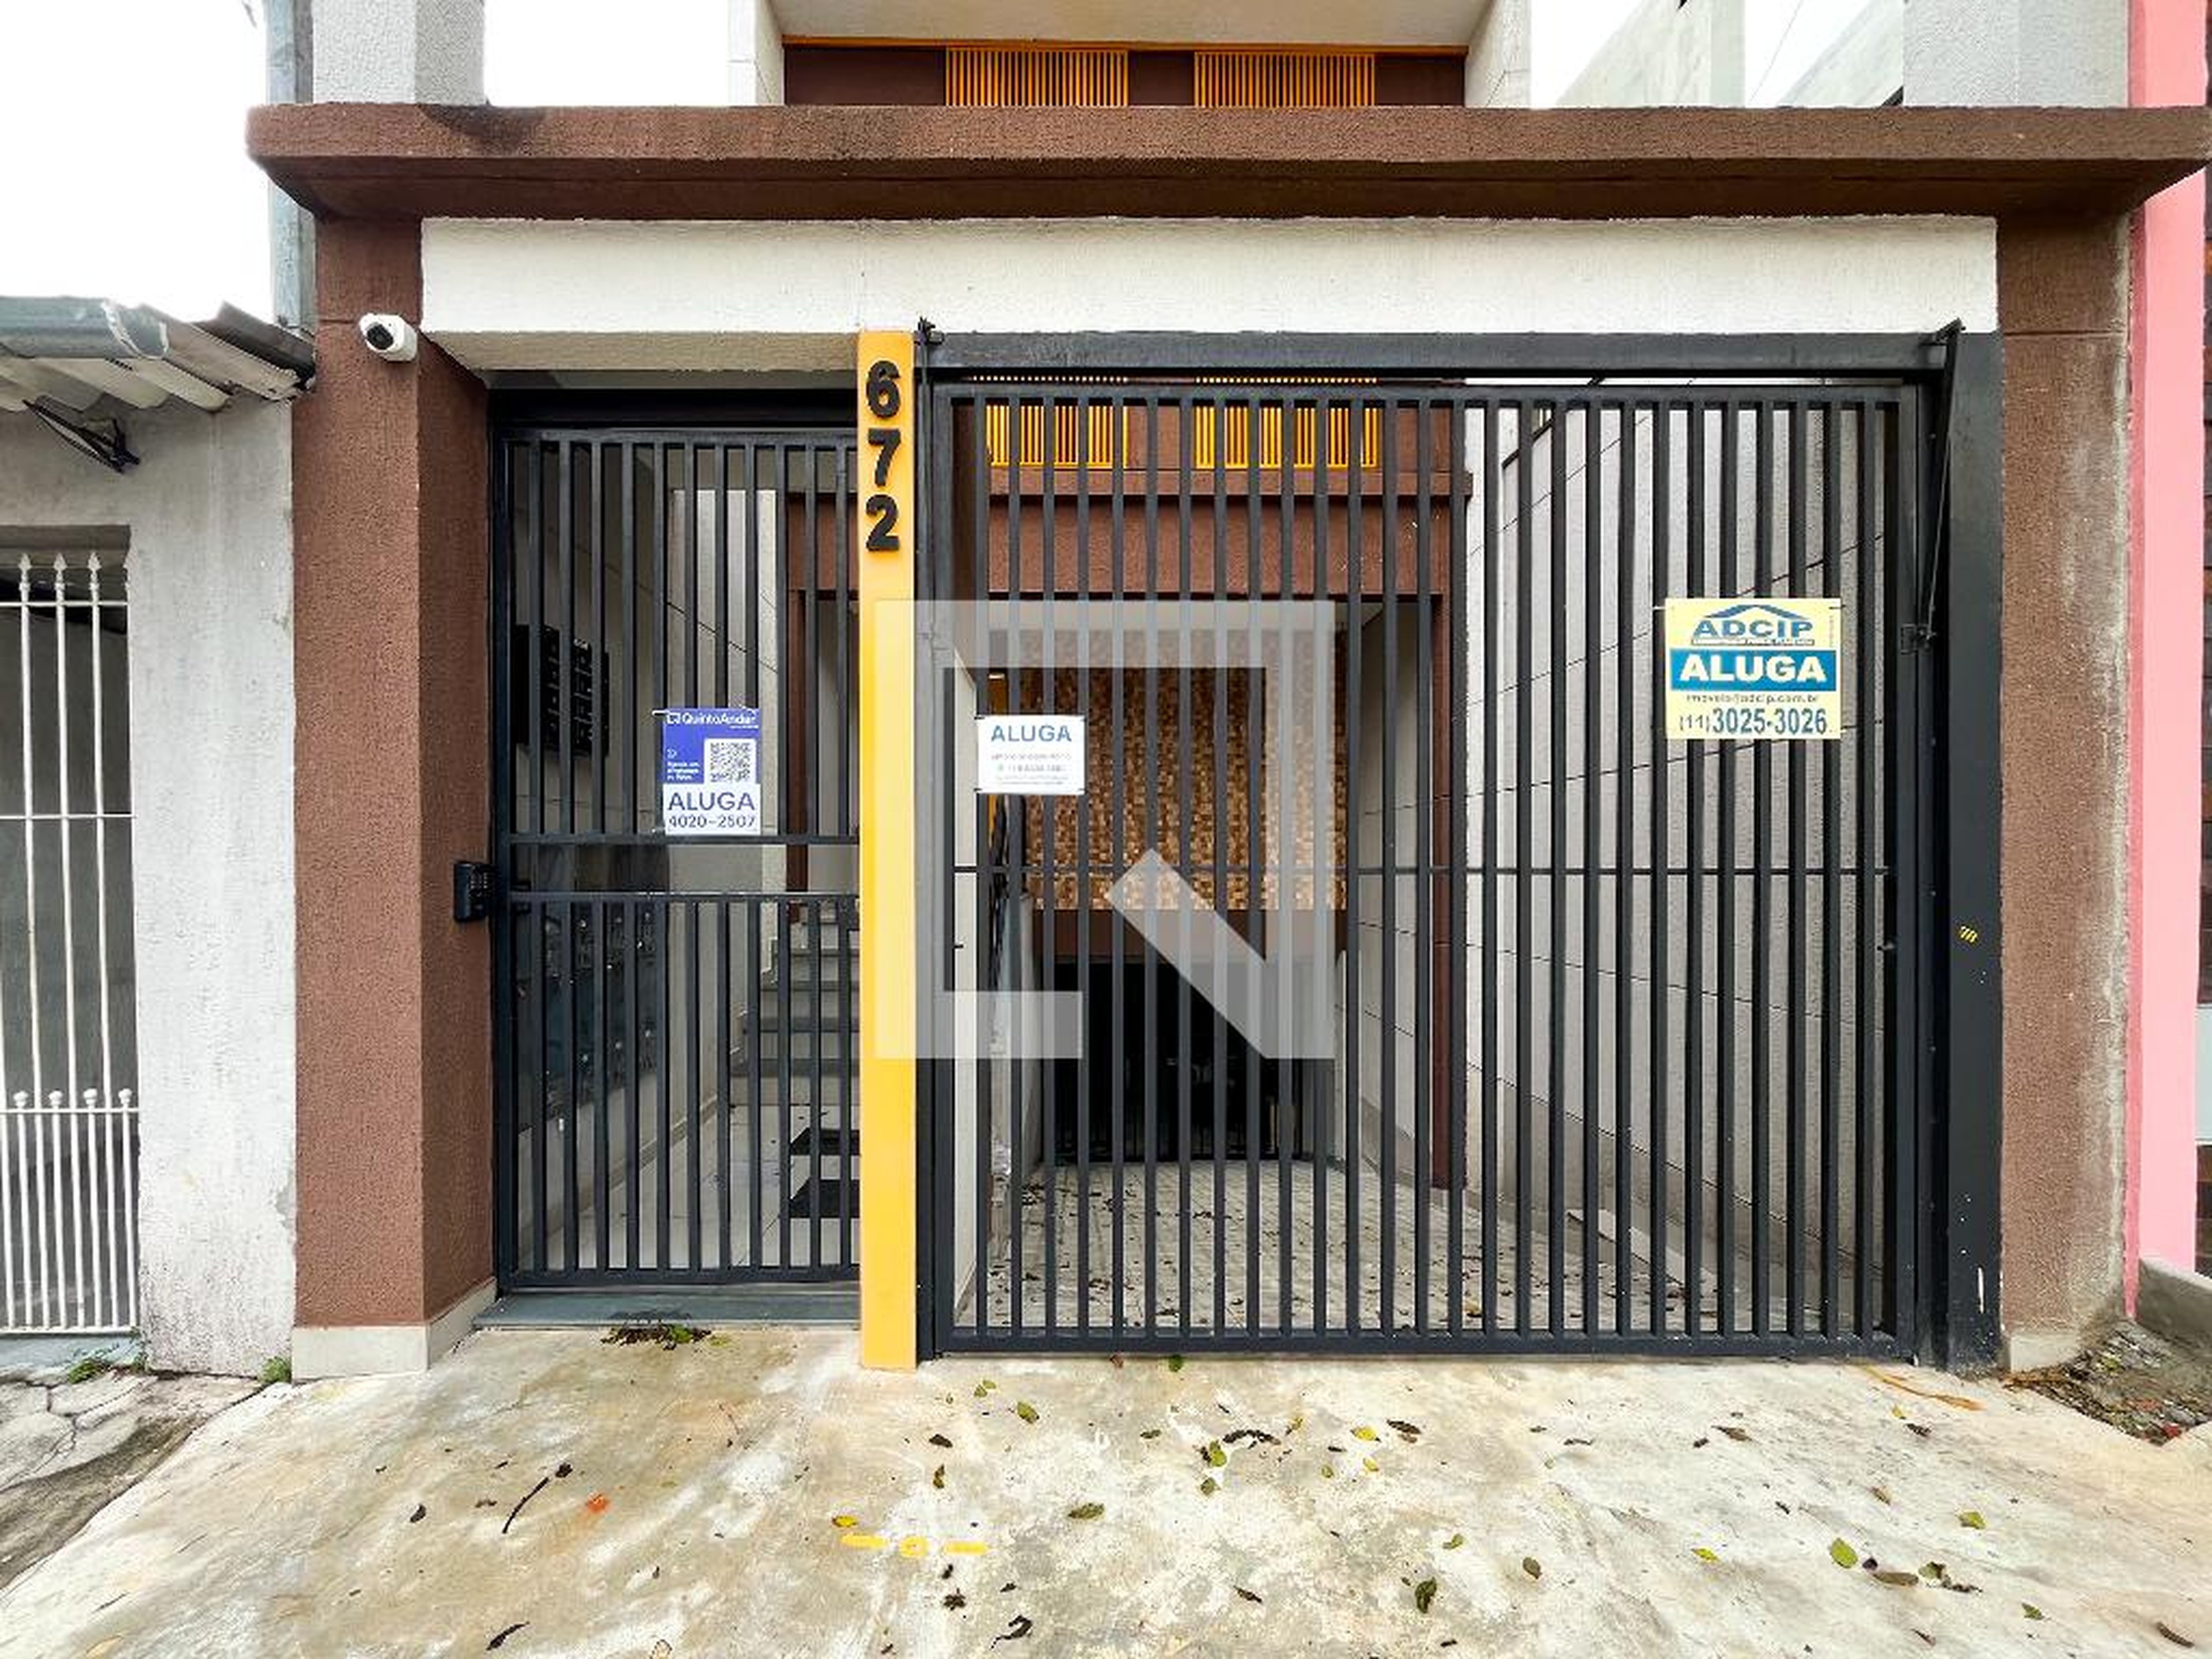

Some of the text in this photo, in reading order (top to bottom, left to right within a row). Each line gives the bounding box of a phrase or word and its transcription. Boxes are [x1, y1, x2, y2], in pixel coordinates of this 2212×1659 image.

[866, 360, 902, 552] 672
[1692, 619, 1813, 638] ADCIP
[1679, 654, 1827, 683] ALUGA
[991, 725, 1072, 742] ALUGA
[668, 792, 755, 811] ALUGA
